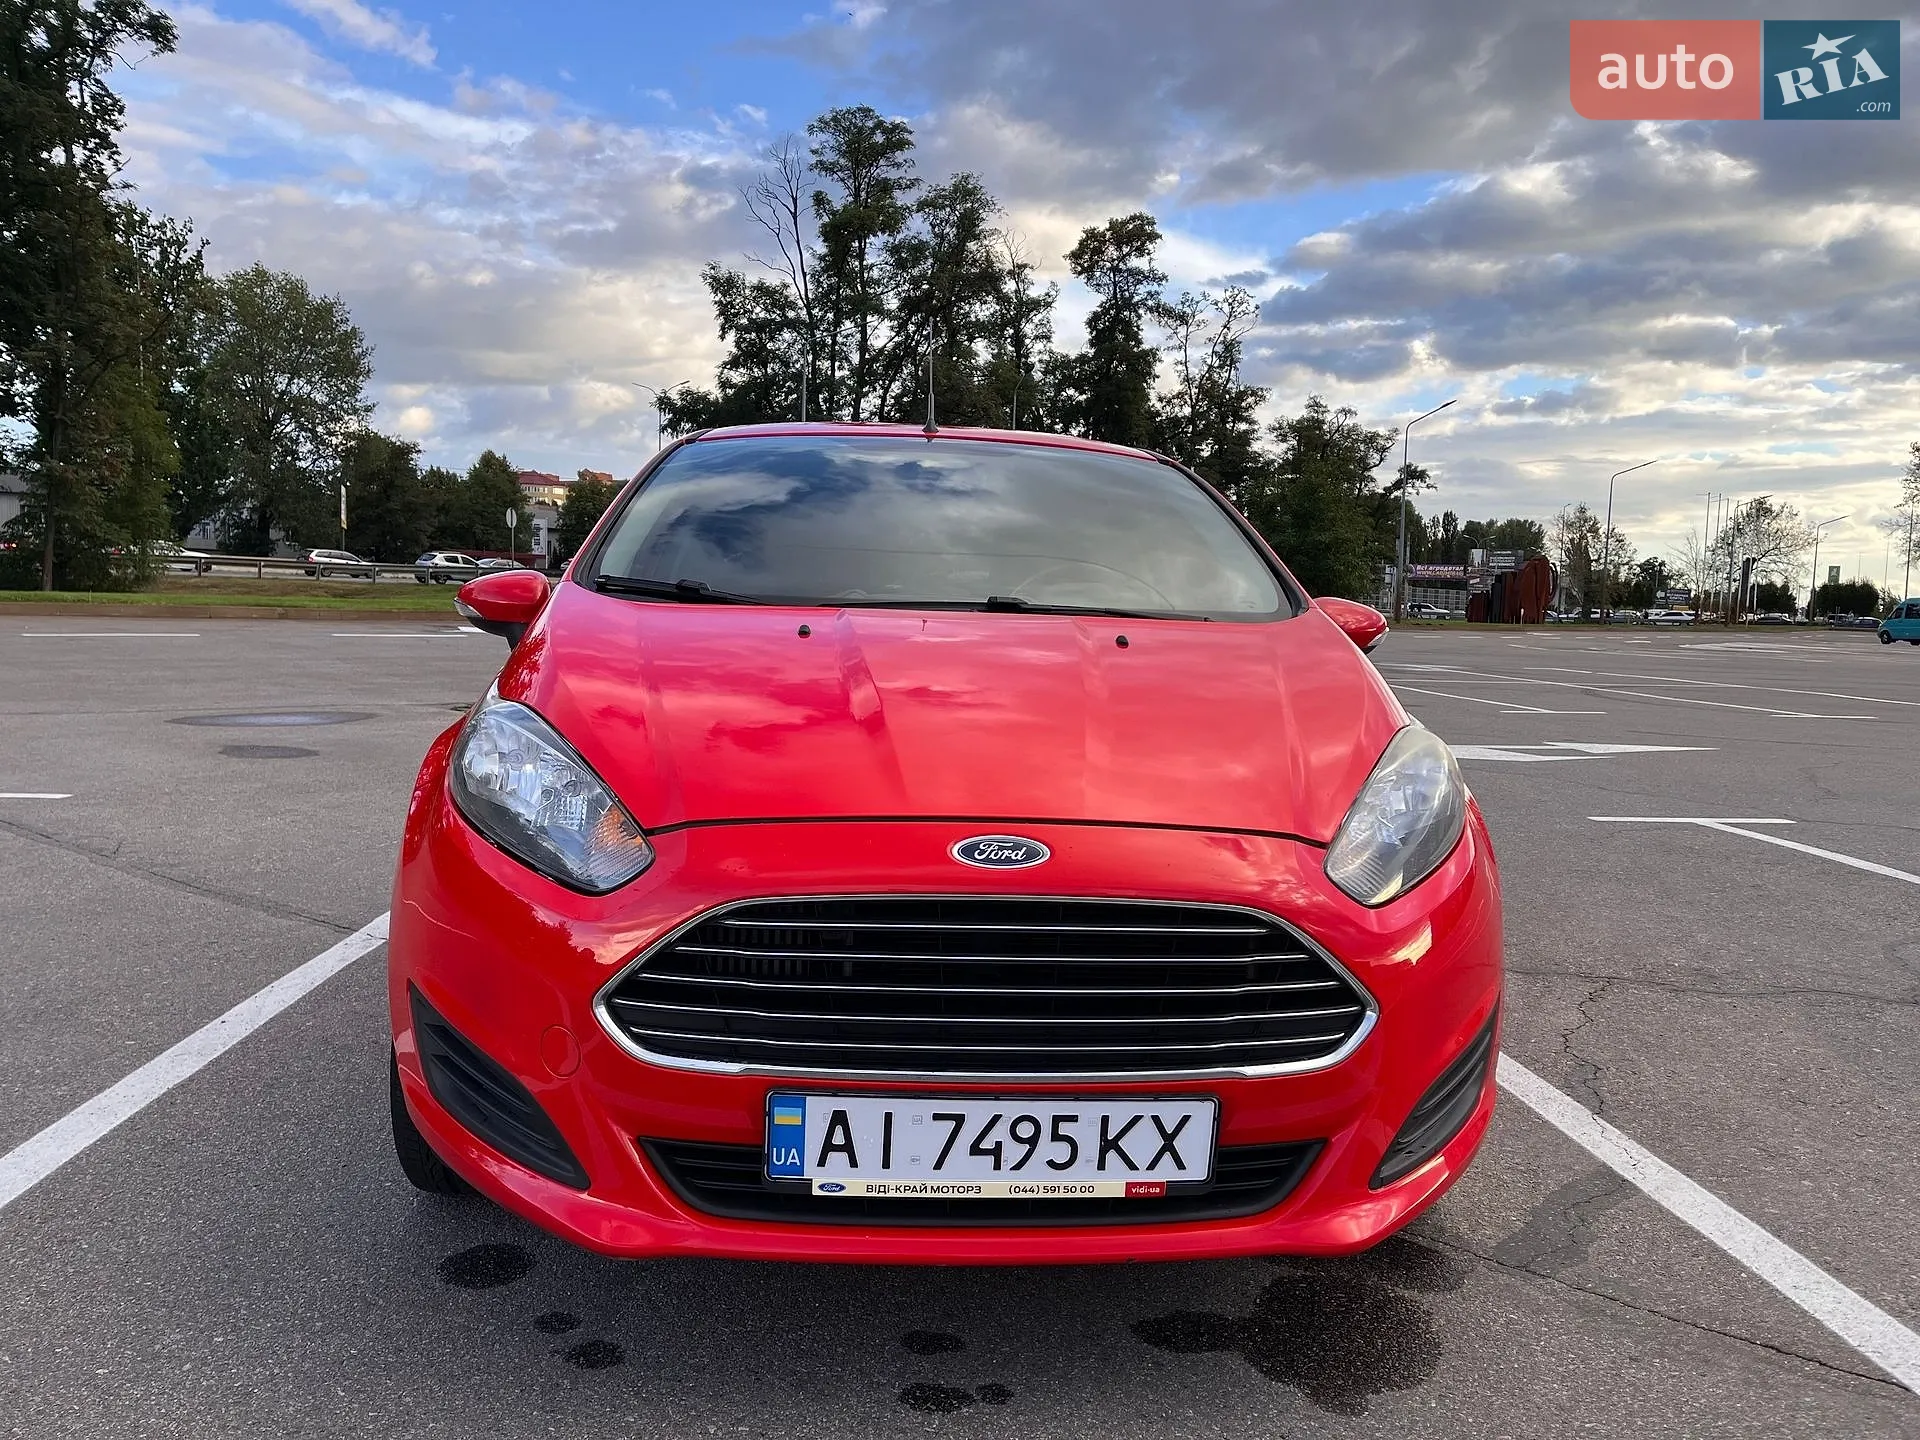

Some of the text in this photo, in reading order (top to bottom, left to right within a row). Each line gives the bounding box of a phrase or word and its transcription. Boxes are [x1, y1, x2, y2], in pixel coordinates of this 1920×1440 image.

[974, 841, 1027, 861] Ford
[931, 1112, 1079, 1171] 7495
[1096, 1114, 1193, 1171] KX
[772, 1147, 801, 1166] UA
[823, 1183, 841, 1192] Ford
[1008, 1184, 1095, 1195] (044) 591 50 00
